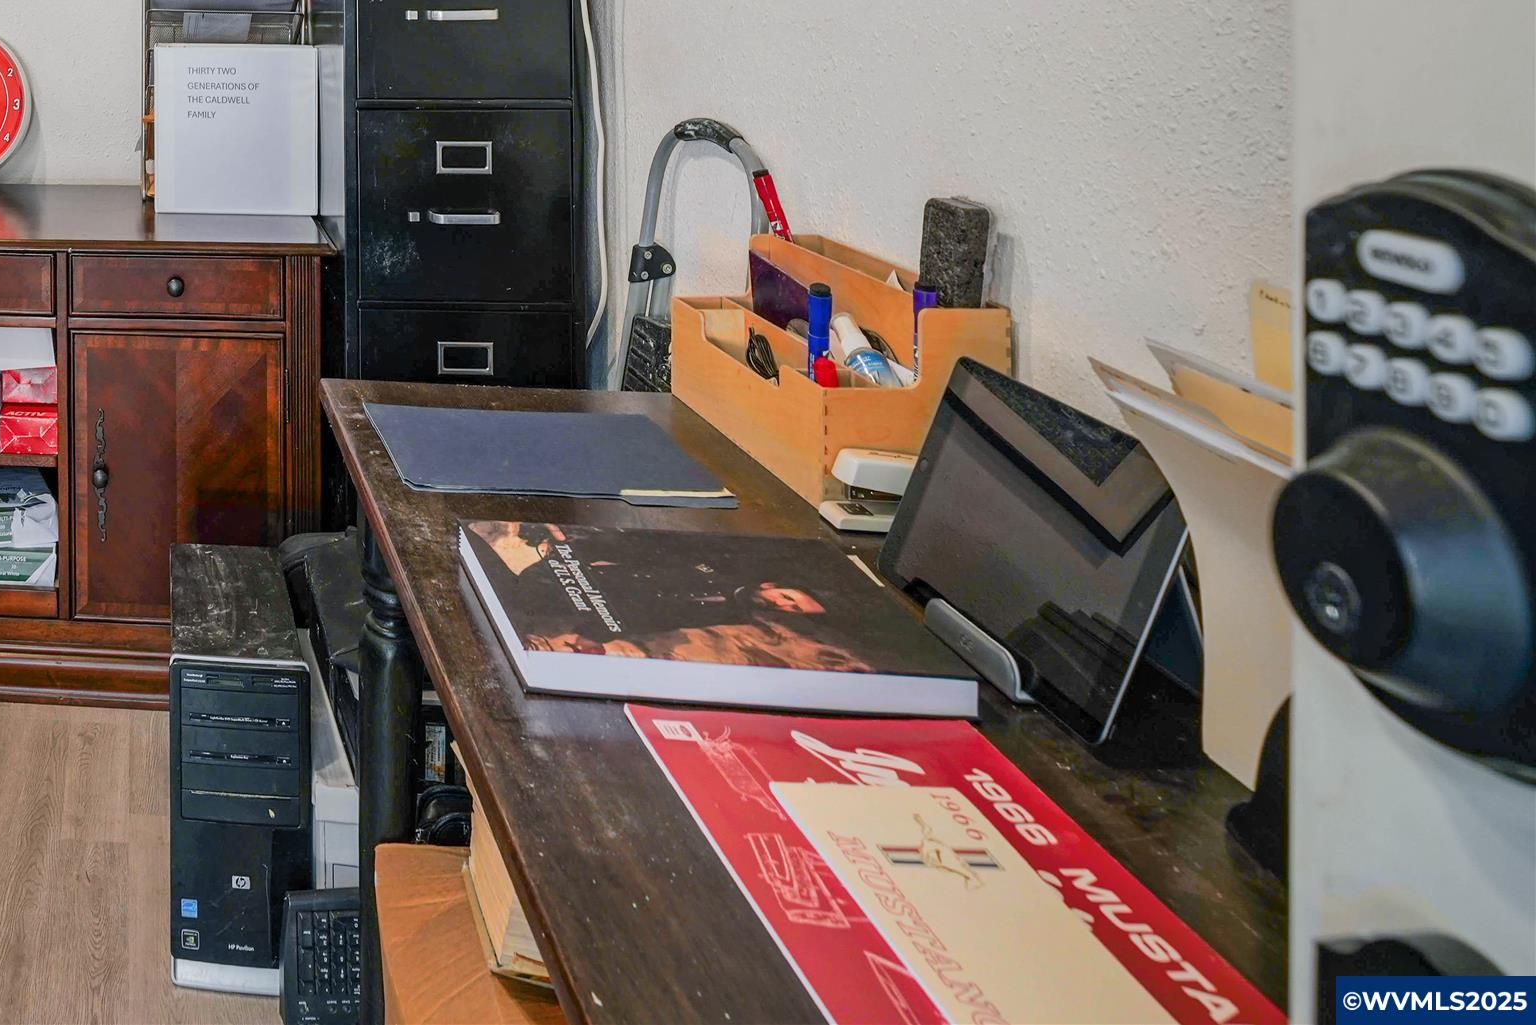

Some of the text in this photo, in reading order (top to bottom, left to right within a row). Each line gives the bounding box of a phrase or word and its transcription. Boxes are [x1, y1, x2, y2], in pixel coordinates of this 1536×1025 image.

[7, 68, 14, 77] 2
[187, 67, 237, 76] THIRTY TWO
[187, 82, 260, 91] GENERATIONS OF
[13, 98, 20, 110] 3
[187, 96, 250, 105] THE CALDWELL
[187, 110, 217, 119] FAMILY
[3, 132, 10, 142] 4
[548, 559, 567, 569] of
[565, 586, 592, 611] Grant
[555, 544, 622, 632] The Personal Memoirs
[930, 793, 990, 841] 1966
[964, 767, 1059, 847] 1966
[1060, 866, 1240, 1024] MUSTA
[236, 944, 255, 952] Pavilion
